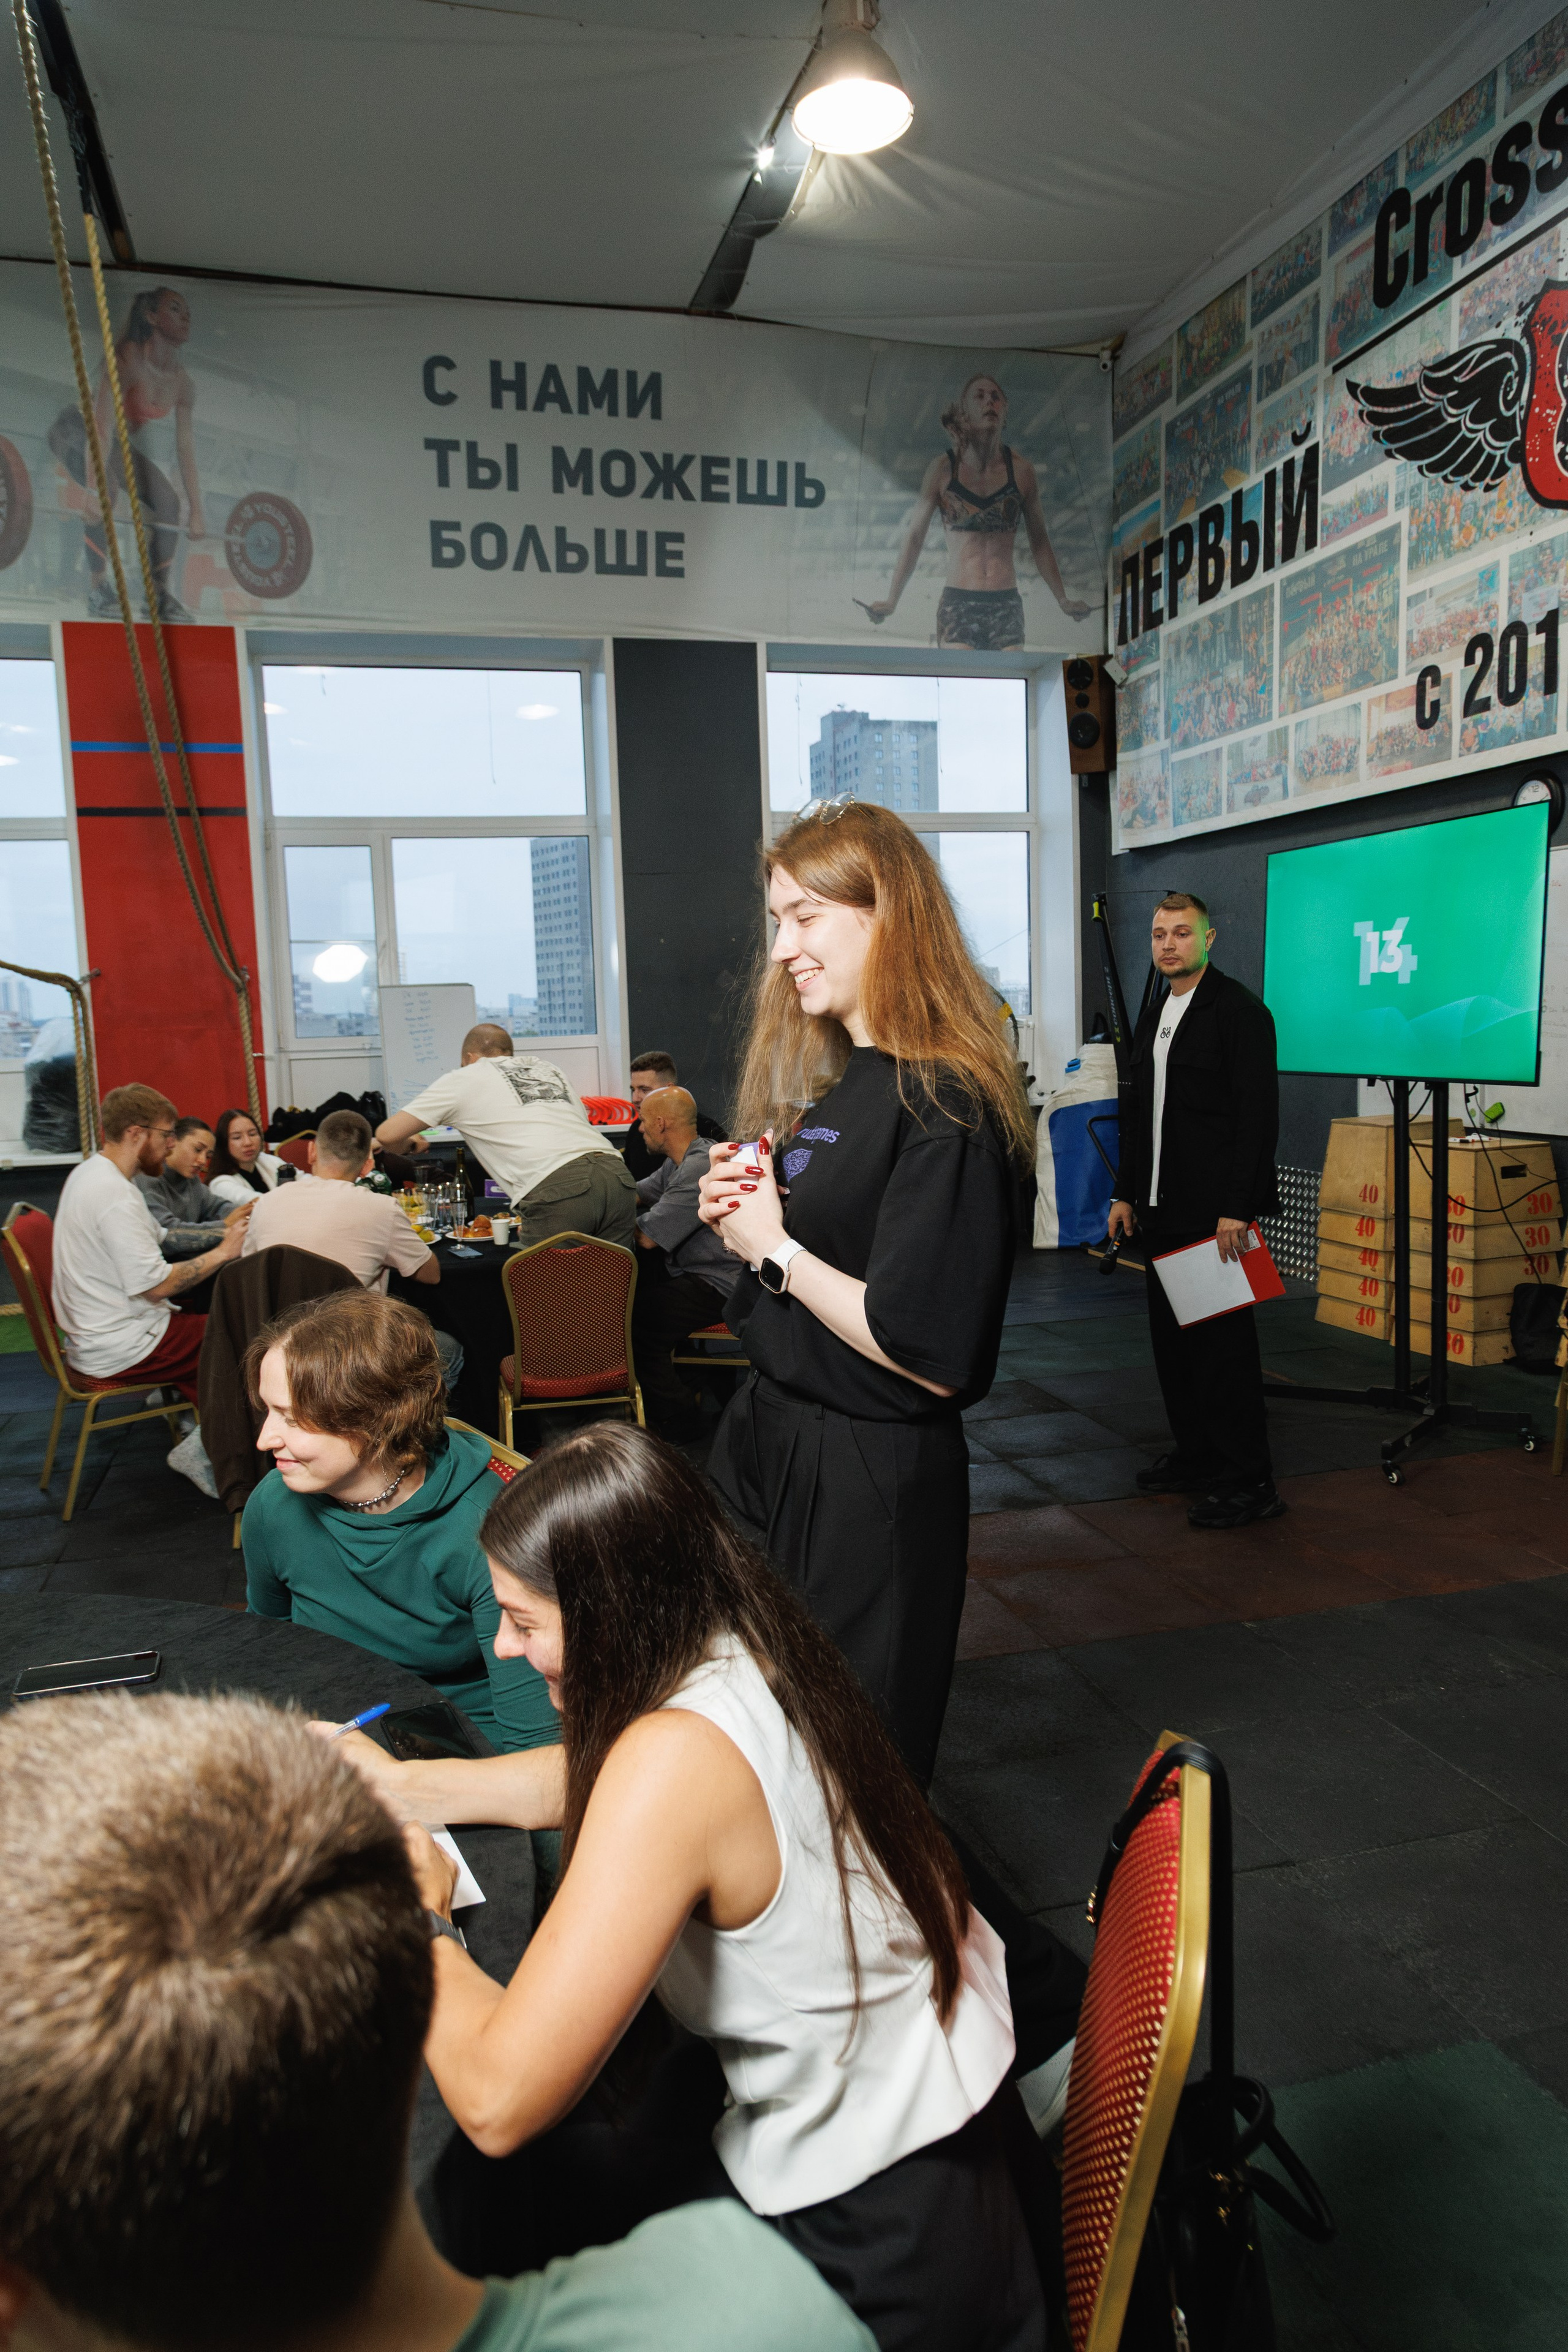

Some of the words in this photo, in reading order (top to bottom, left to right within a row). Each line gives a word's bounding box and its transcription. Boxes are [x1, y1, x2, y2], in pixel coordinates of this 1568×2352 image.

[423, 355, 458, 406] С
[489, 359, 662, 420] НАМИ
[424, 438, 518, 491] ТЫ
[552, 446, 825, 508] МОЖЕШЬ
[1118, 421, 1319, 646] ПЕРВЫЙ
[430, 521, 685, 578] БОЛЬШЕ
[1463, 608, 1559, 718] 201
[1366, 930, 1403, 973] 13
[1359, 1184, 1379, 1204] 40
[1526, 1192, 1553, 1215] 30
[1355, 1217, 1376, 1237] 40
[1525, 1224, 1550, 1248] 30
[1359, 1248, 1379, 1268] 40
[1523, 1254, 1550, 1276] 30
[1359, 1277, 1379, 1297] 40
[1449, 1295, 1461, 1314] 0
[1355, 1306, 1376, 1327] 40
